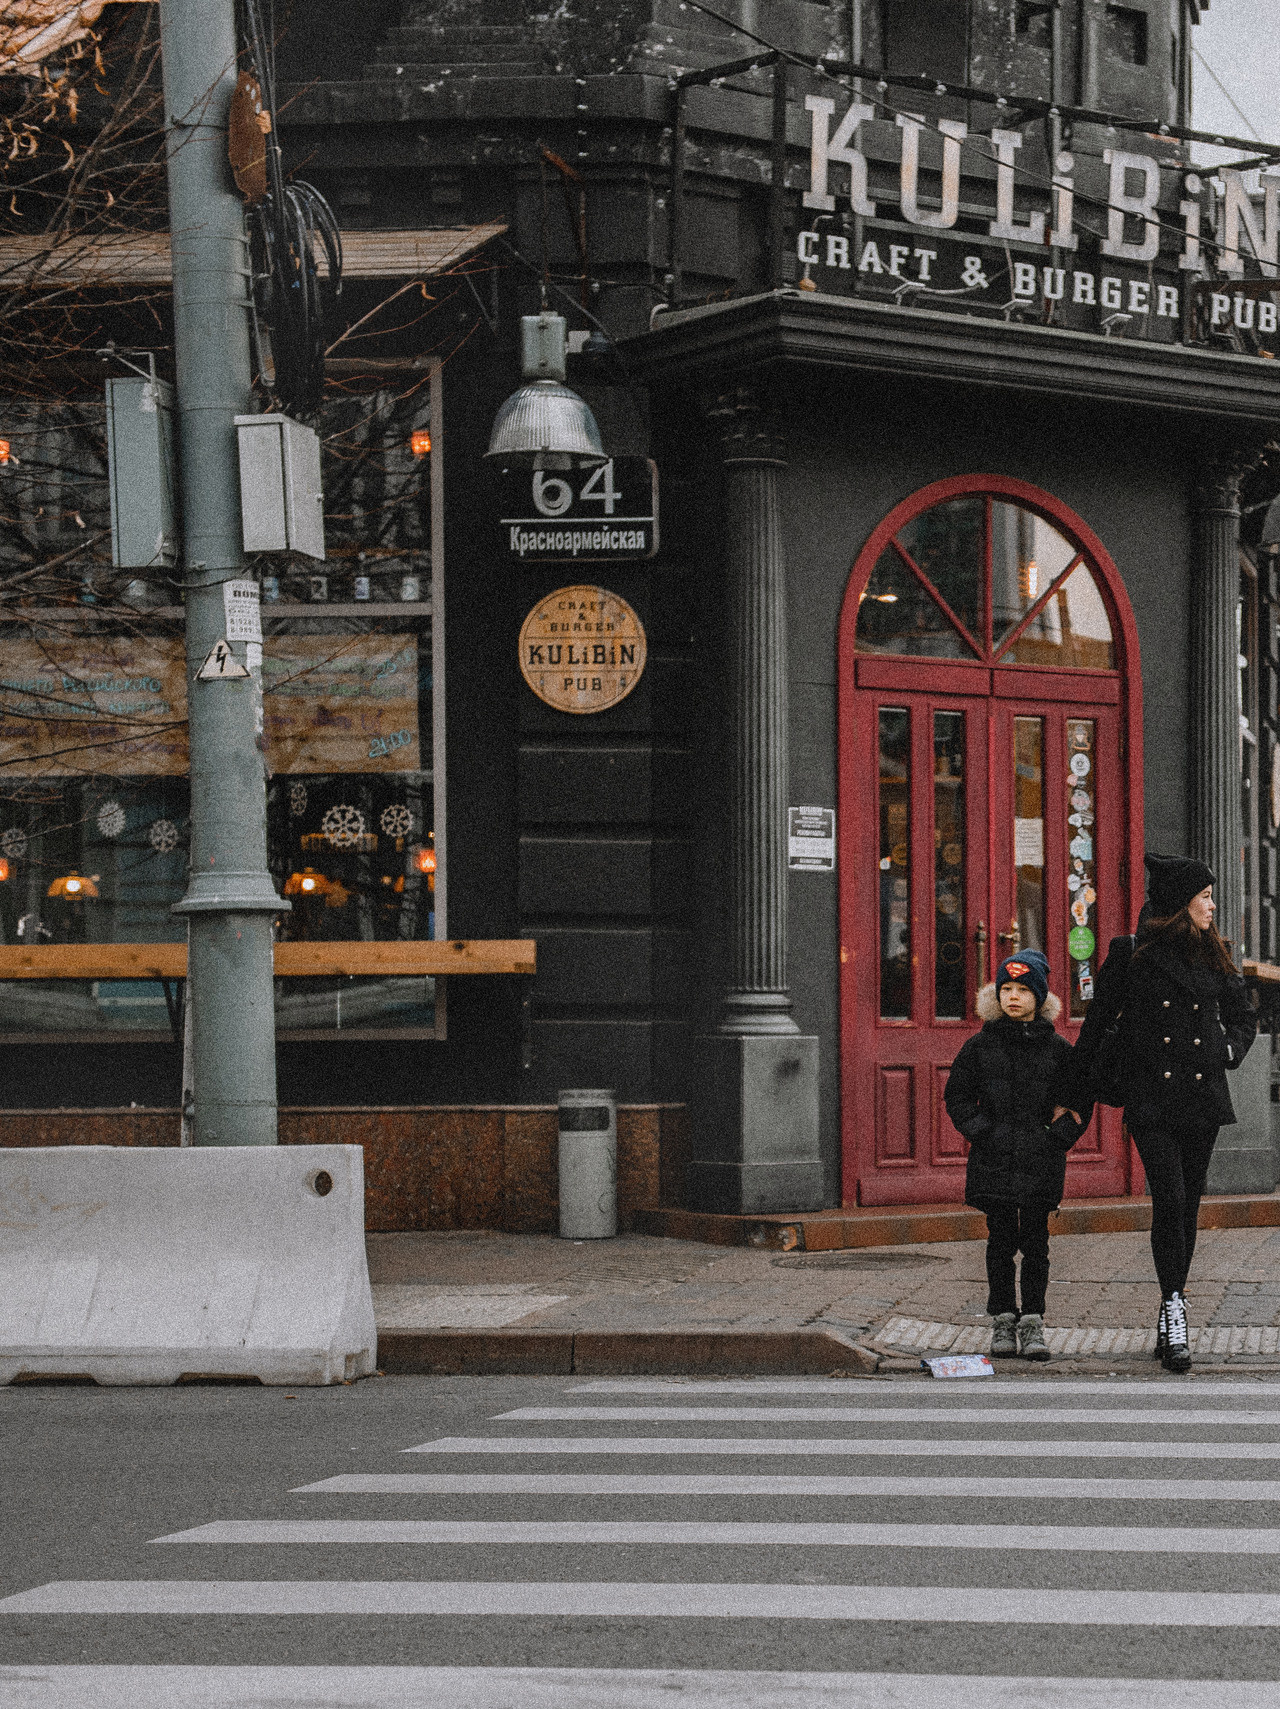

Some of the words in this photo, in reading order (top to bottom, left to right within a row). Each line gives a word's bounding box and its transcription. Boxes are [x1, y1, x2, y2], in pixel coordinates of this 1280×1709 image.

[798, 230, 937, 281] CRAFT
[961, 256, 989, 288] &
[1014, 262, 1179, 319] BURGER
[1210, 292, 1278, 333] PUB
[532, 458, 622, 517] 64
[510, 525, 645, 556] Красноармейская
[558, 601, 607, 611] CRAFT
[550, 622, 615, 632] BURGER
[563, 677, 602, 692] PUB
